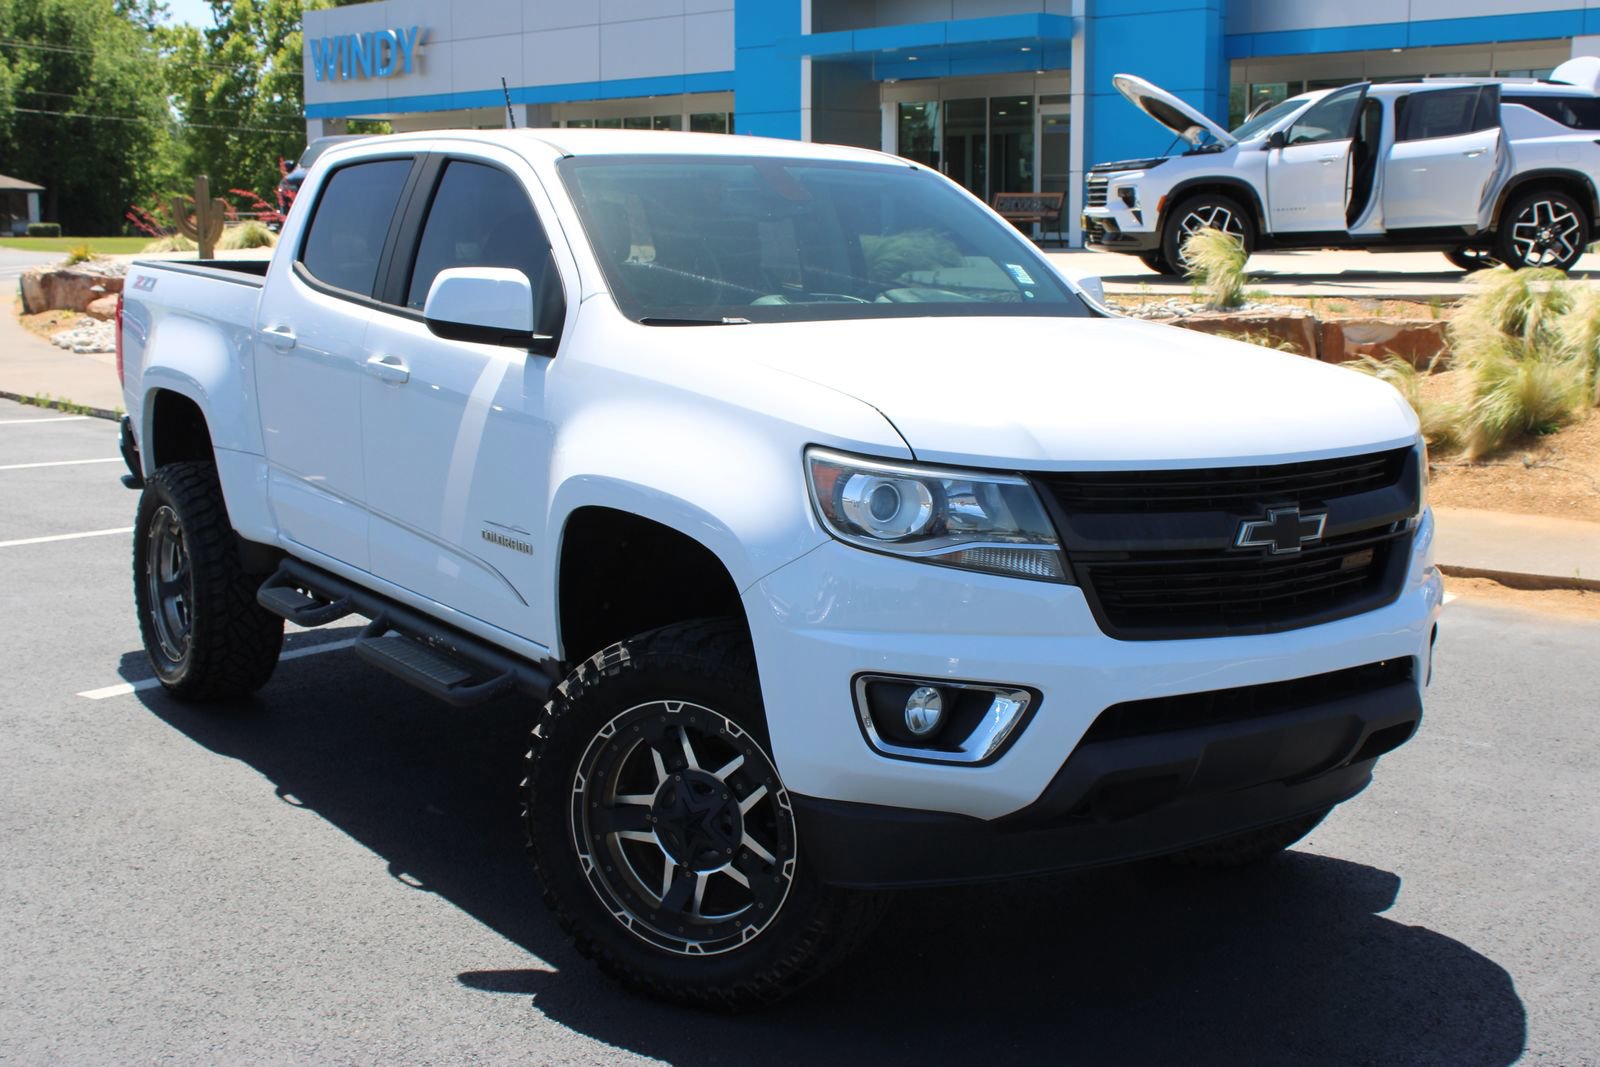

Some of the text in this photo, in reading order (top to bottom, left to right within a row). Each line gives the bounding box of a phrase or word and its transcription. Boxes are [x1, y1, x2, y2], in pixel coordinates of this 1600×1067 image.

[309, 26, 419, 82] WINDY
[132, 275, 158, 292] Z71
[481, 529, 534, 555] COLORADO
